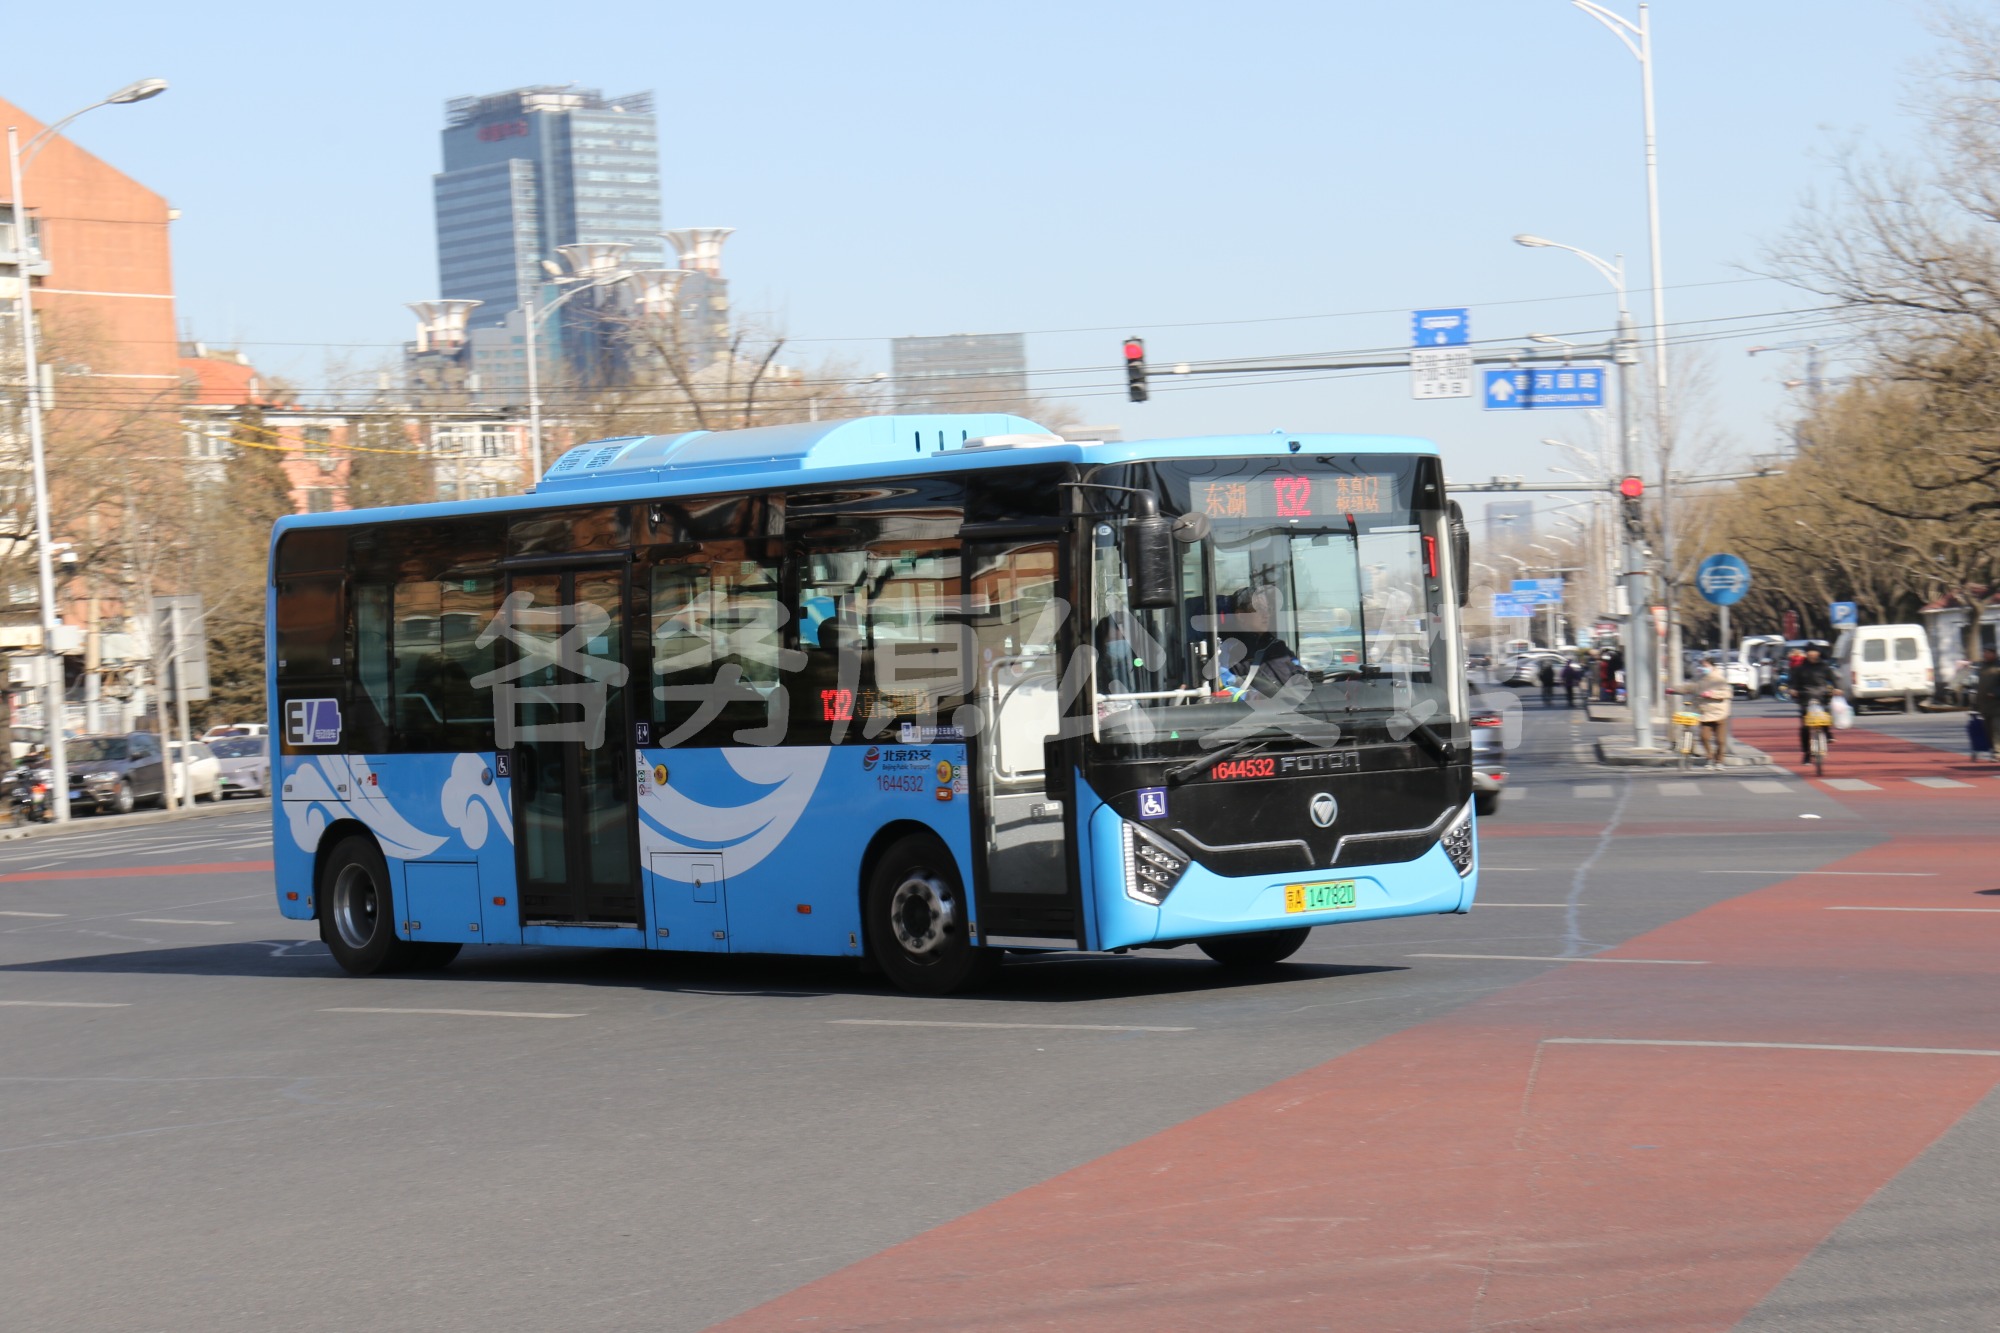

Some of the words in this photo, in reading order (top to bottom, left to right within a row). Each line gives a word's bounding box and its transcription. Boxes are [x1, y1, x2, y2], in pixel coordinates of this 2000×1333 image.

[1336, 476, 1379, 496] 东直门
[1273, 476, 1312, 517] 132
[1835, 604, 1851, 620] P
[820, 689, 853, 721] 132
[883, 749, 932, 761] 北京公交
[882, 764, 896, 772] Beijing
[910, 763, 931, 772] Transport
[1211, 758, 1275, 780] 1644532
[1280, 751, 1360, 772] FOTON
[877, 775, 924, 792] 1644532
